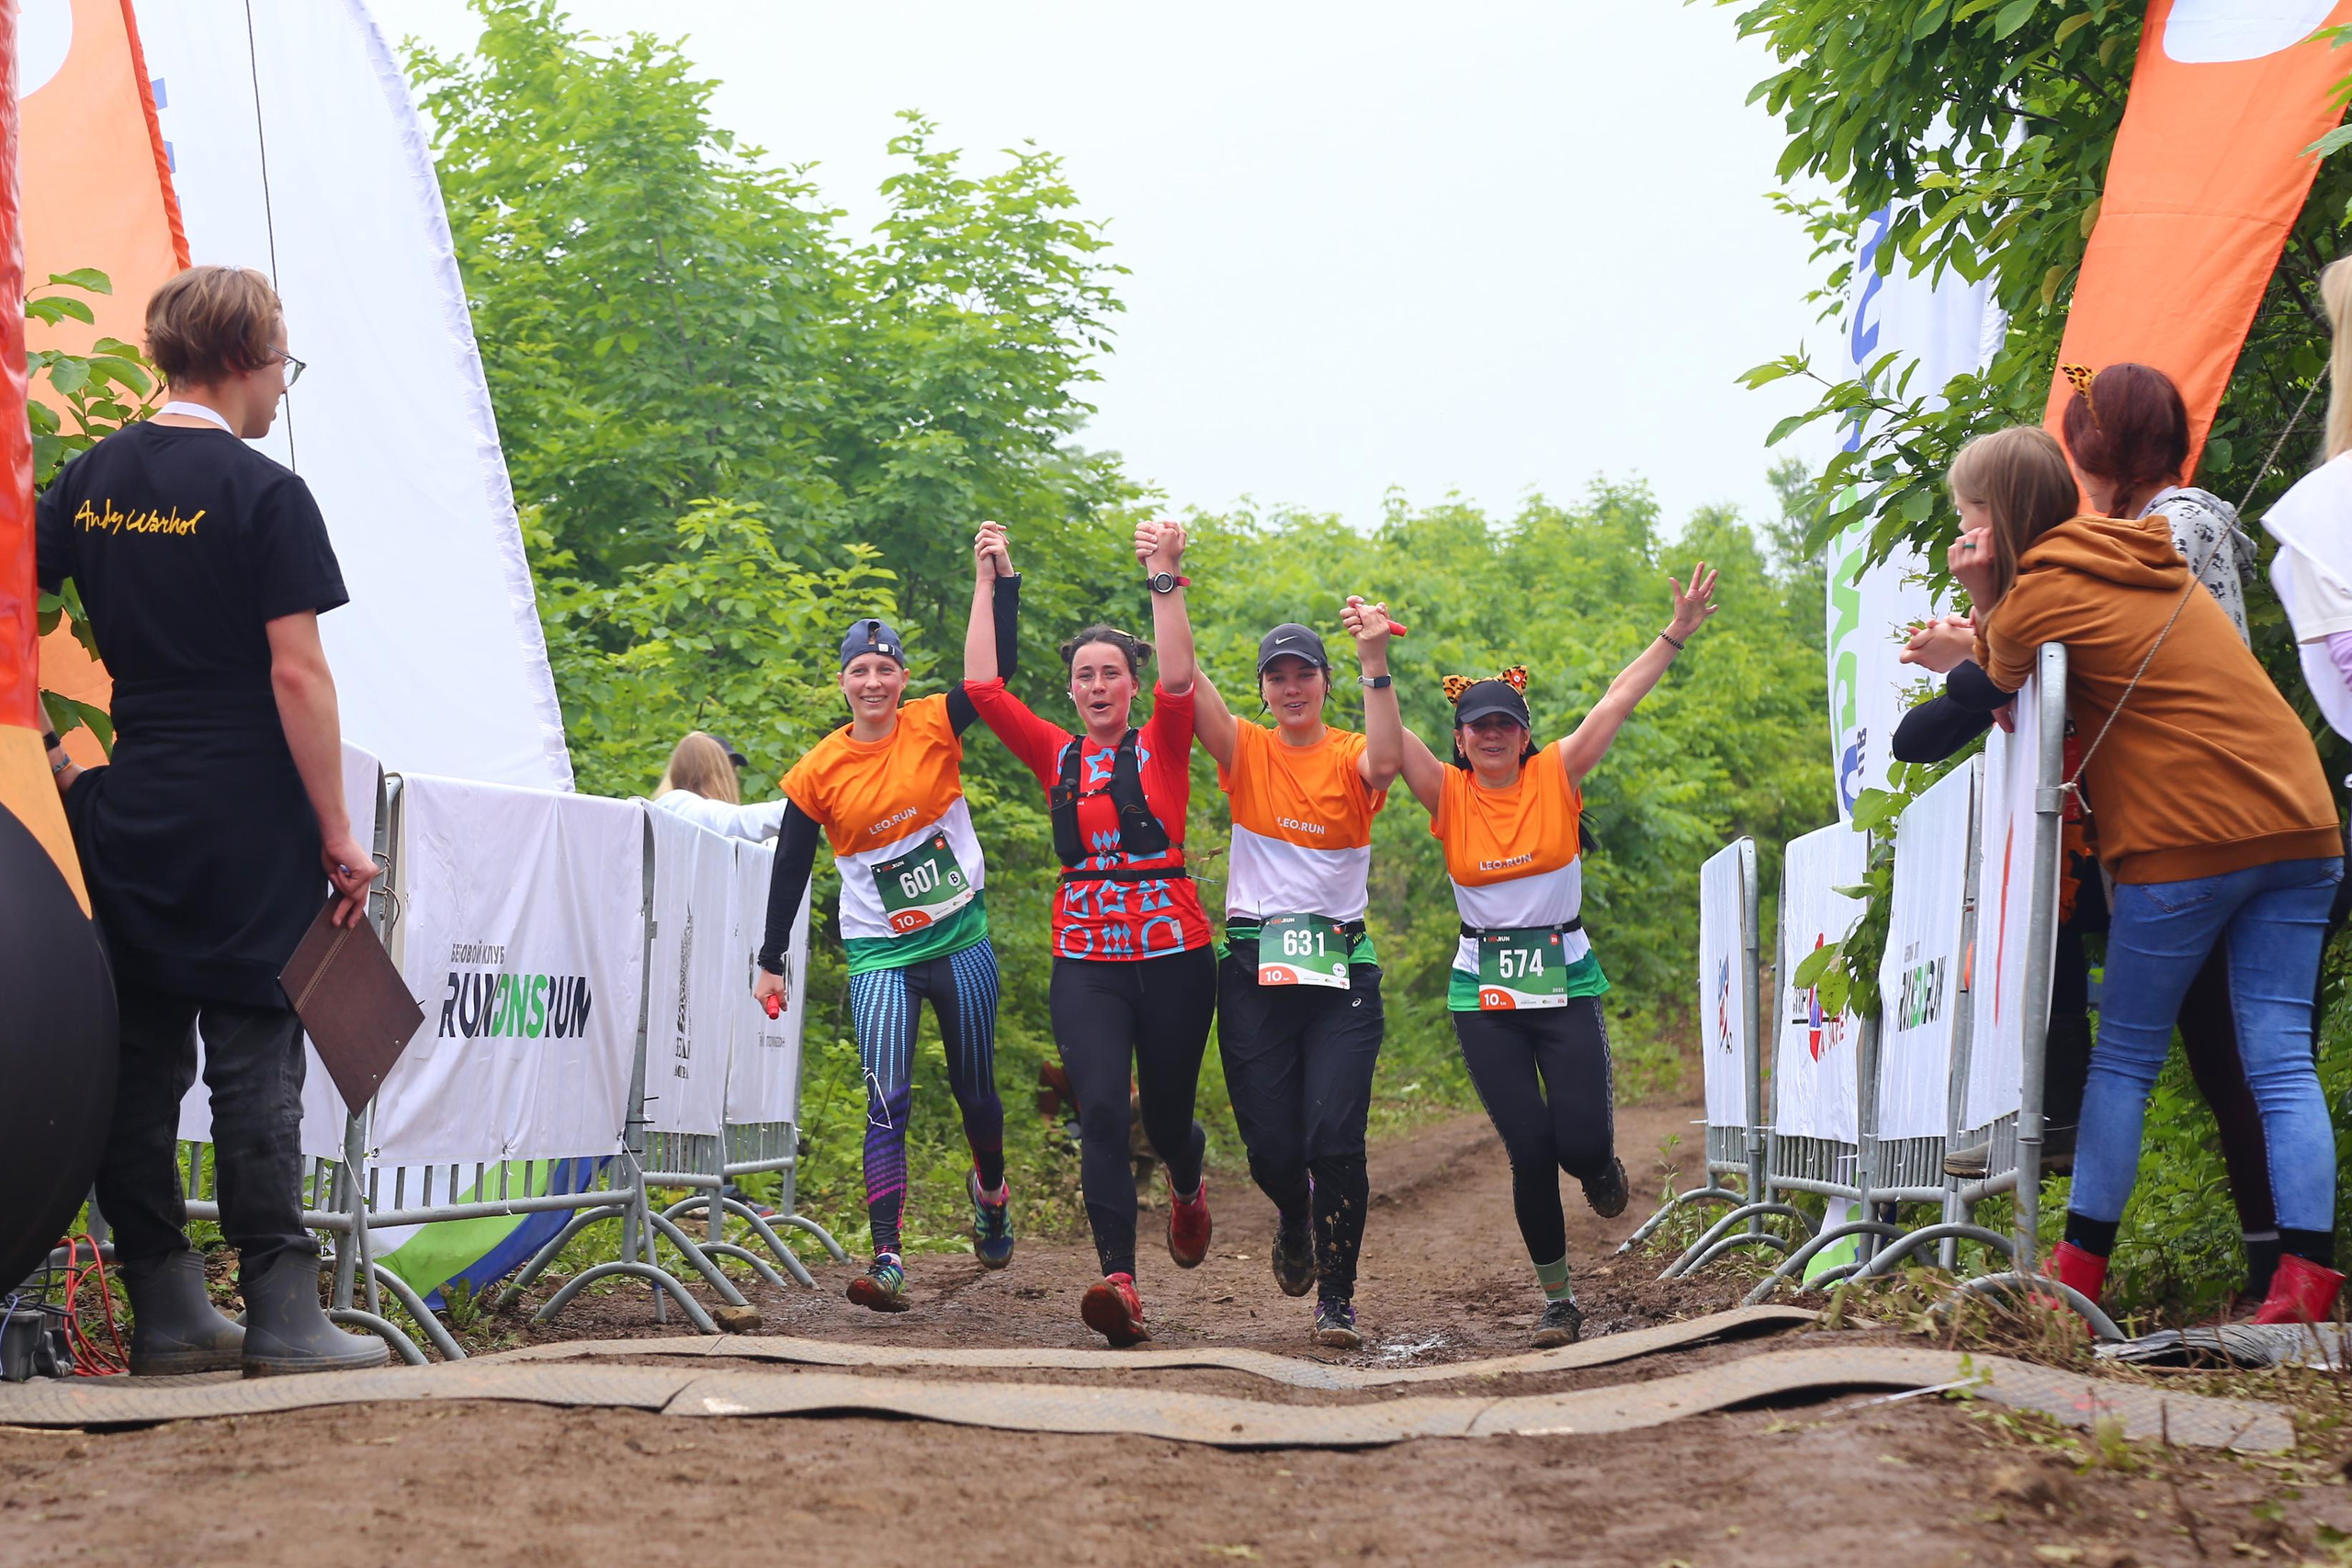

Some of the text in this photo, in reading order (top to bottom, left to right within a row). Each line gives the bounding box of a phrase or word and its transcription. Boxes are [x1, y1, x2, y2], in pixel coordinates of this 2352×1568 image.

[74, 498, 207, 536] Andy Warhol
[868, 806, 918, 836] LEO.RUN
[1277, 816, 1326, 835] LEO.RUN
[1478, 852, 1533, 872] LEO.RUN
[899, 857, 941, 899] 607
[896, 914, 915, 929] 10
[1283, 929, 1325, 957] 631
[481, 944, 505, 964] КЛУБ
[1499, 948, 1544, 979] 574
[1265, 969, 1283, 982] 10
[1484, 992, 1499, 1007] 10
